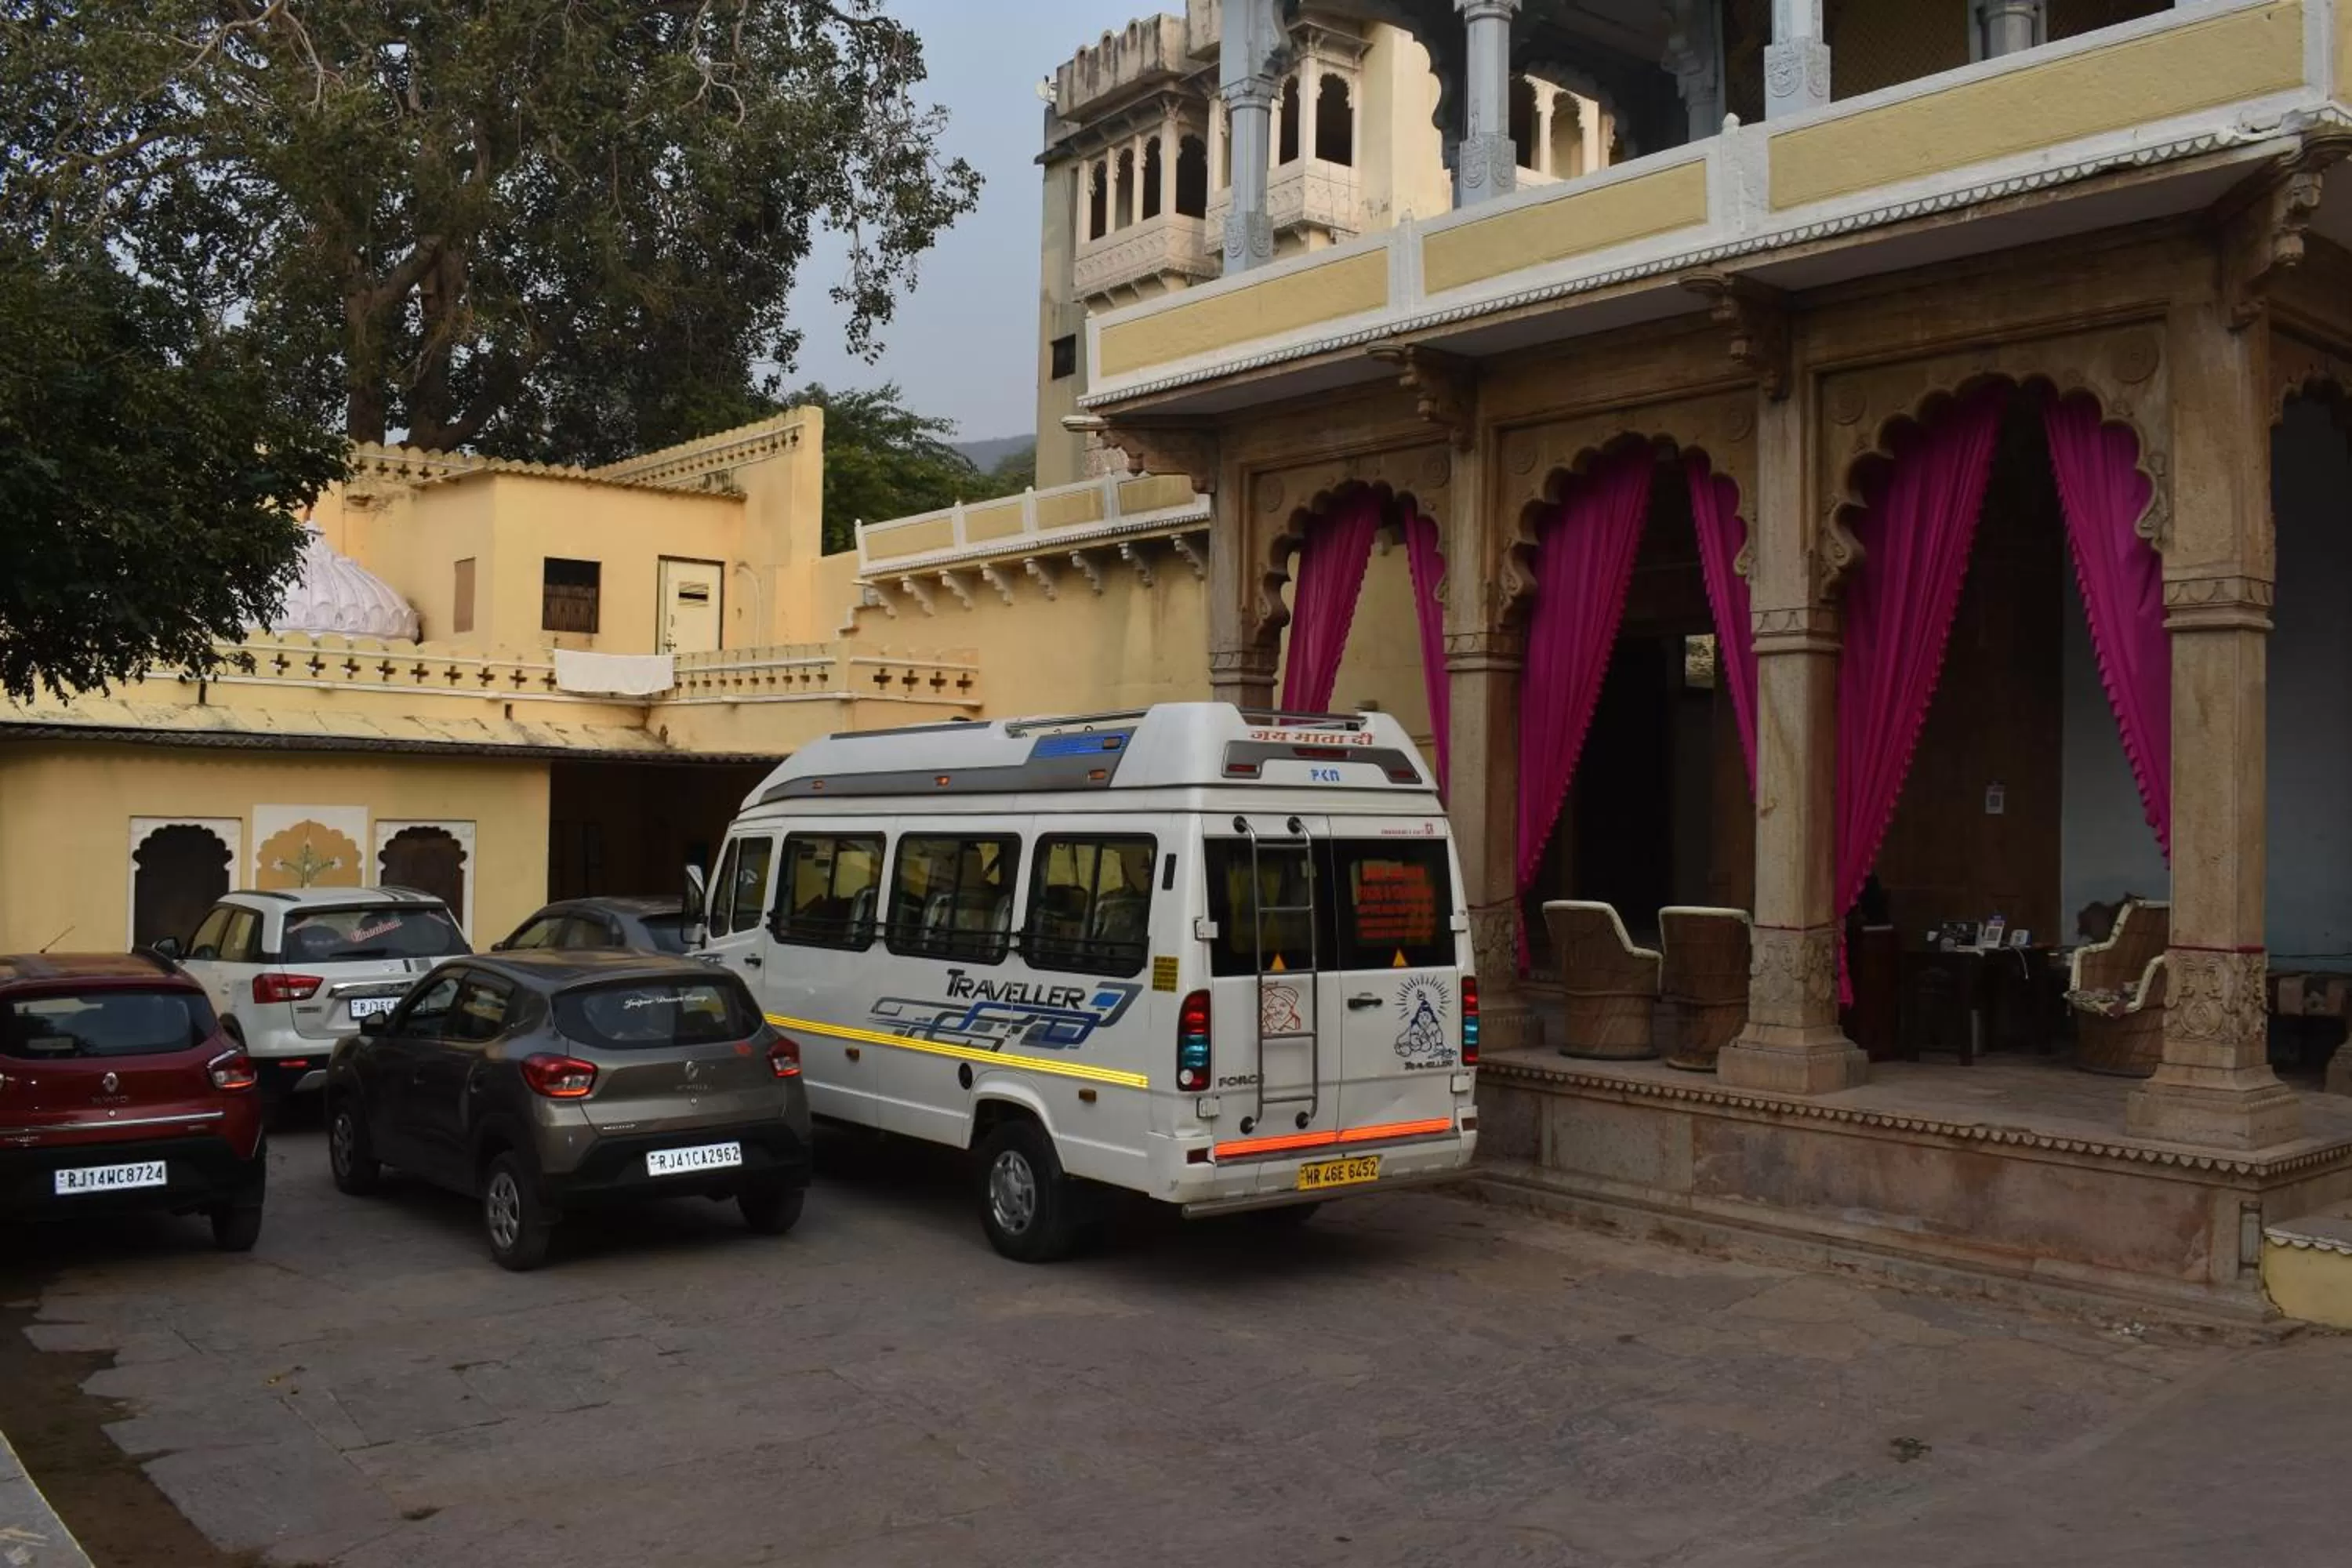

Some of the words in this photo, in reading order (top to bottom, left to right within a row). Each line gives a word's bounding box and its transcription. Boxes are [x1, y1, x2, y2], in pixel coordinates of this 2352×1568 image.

[946, 968, 1087, 1011] TRAVELLER
[1218, 1074, 1259, 1087] FORC
[1305, 1167, 1321, 1185] HR
[1348, 1160, 1377, 1179] 6452
